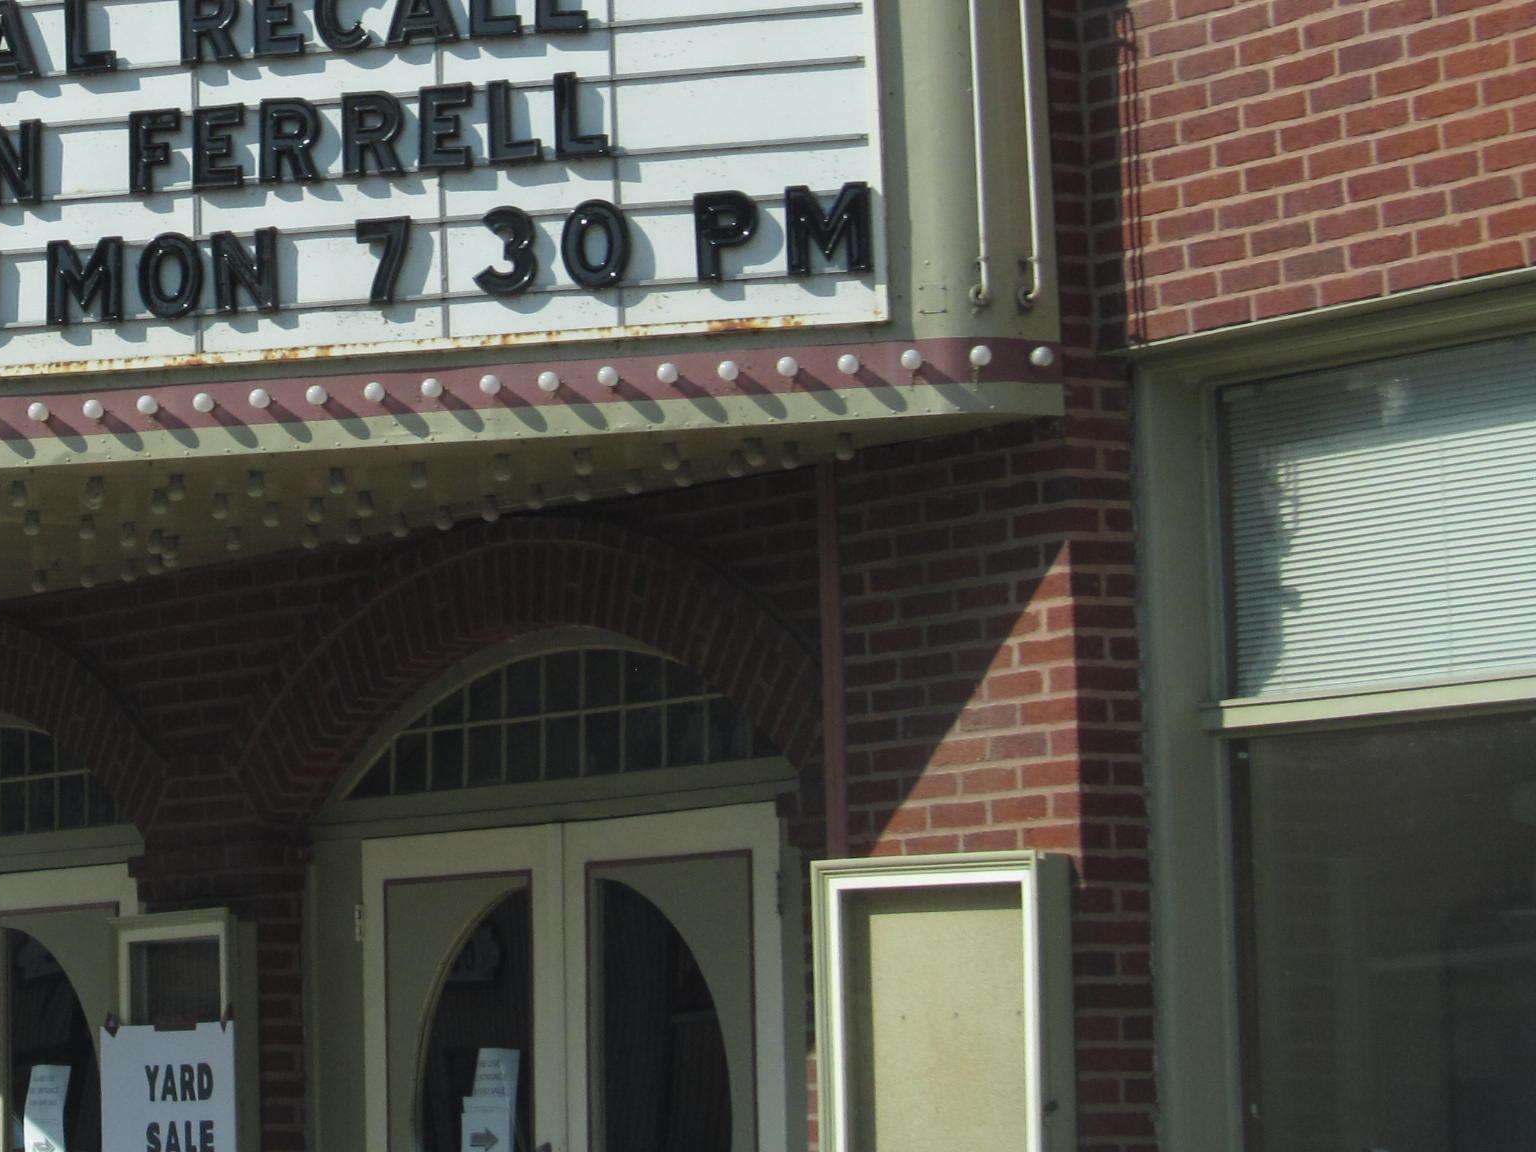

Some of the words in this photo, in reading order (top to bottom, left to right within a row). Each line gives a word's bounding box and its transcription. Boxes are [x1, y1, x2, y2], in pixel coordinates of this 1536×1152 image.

[128, 71, 611, 194] FERRELL
[46, 226, 281, 326] MON
[693, 181, 874, 283] PM
[144, 1062, 215, 1102] YARD
[146, 1120, 215, 1152] SALE
